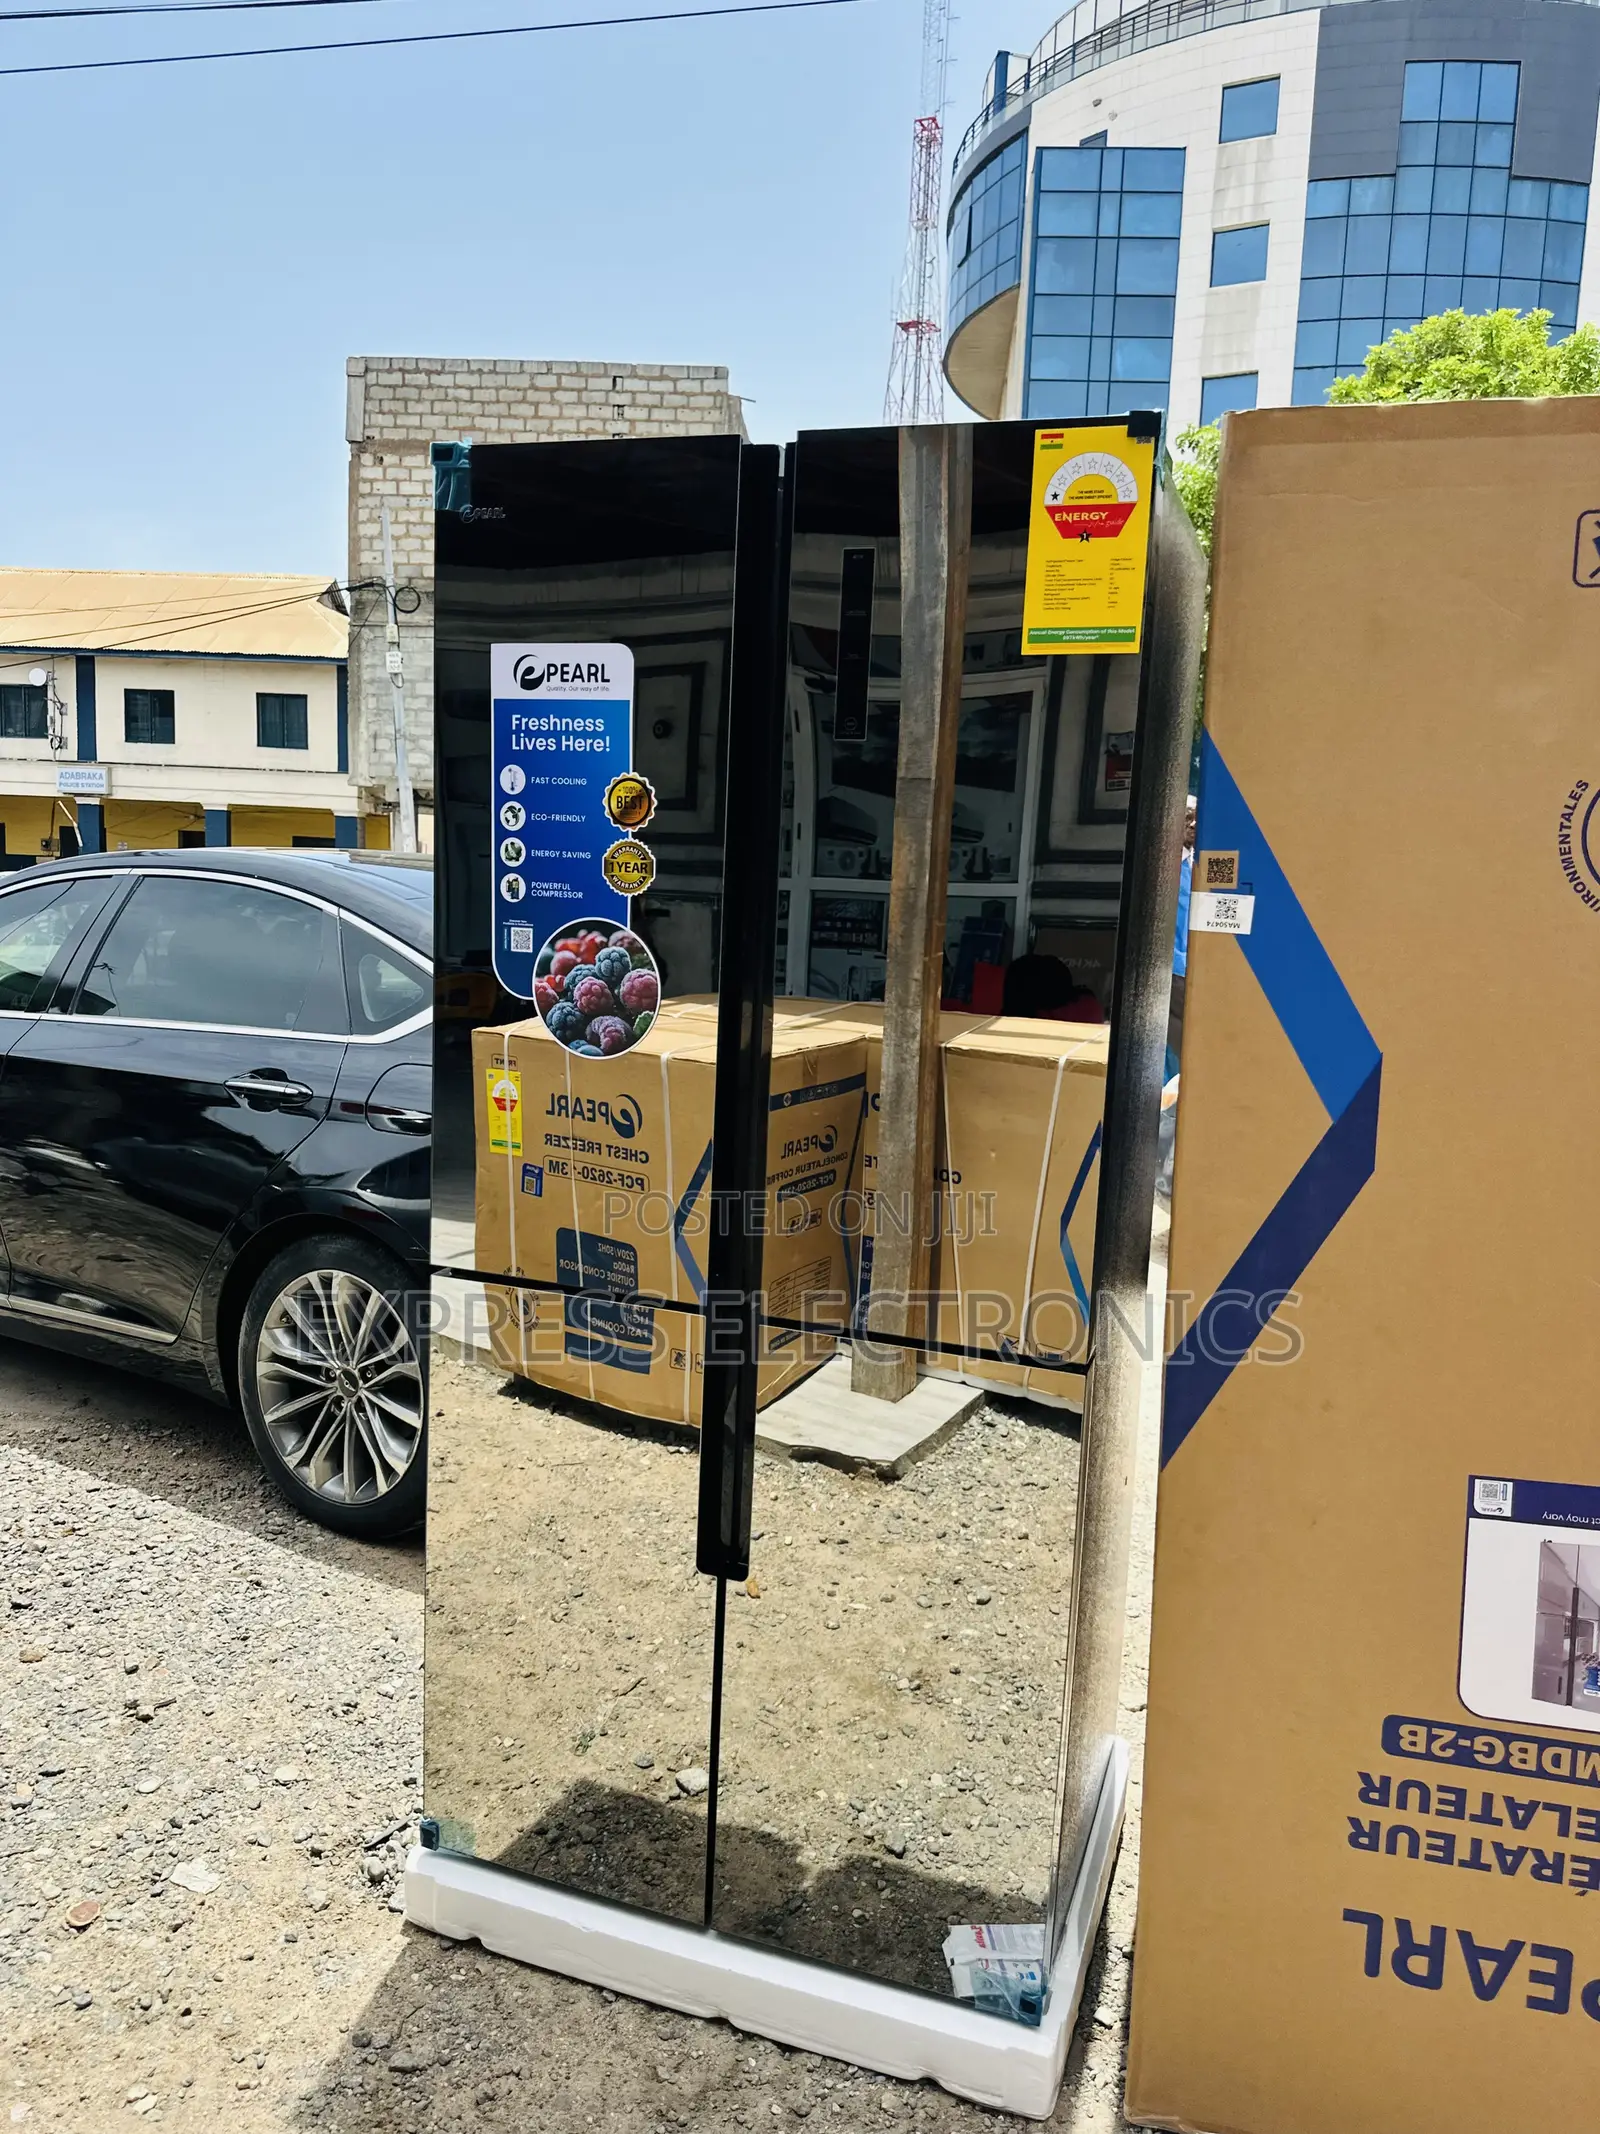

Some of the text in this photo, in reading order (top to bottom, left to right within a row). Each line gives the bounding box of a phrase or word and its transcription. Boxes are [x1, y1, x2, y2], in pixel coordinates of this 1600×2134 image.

[1054, 511, 1109, 523] ENERGY
[546, 663, 611, 683] PEARL
[511, 714, 605, 731] Freshness
[511, 733, 611, 752] Lives Here!
[59, 772, 104, 780] ADABRAKA
[551, 777, 588, 785] COOLING
[616, 796, 644, 810] BEST
[531, 813, 586, 822] ECO-FRIENDLY
[531, 850, 592, 859] ENERGY SAVING
[613, 846, 644, 859] WARRANTY
[609, 862, 648, 874] 1 YEAR
[531, 882, 571, 890] POWERFUL
[612, 875, 644, 889] WARRANTY
[531, 889, 584, 899] COMPRESSOR
[1541, 1511, 1564, 1521] vary
[1566, 1513, 1589, 1523] may
[1357, 1771, 1600, 1843] ELATEUR
[1346, 1815, 1600, 1897] ÉRATEUR
